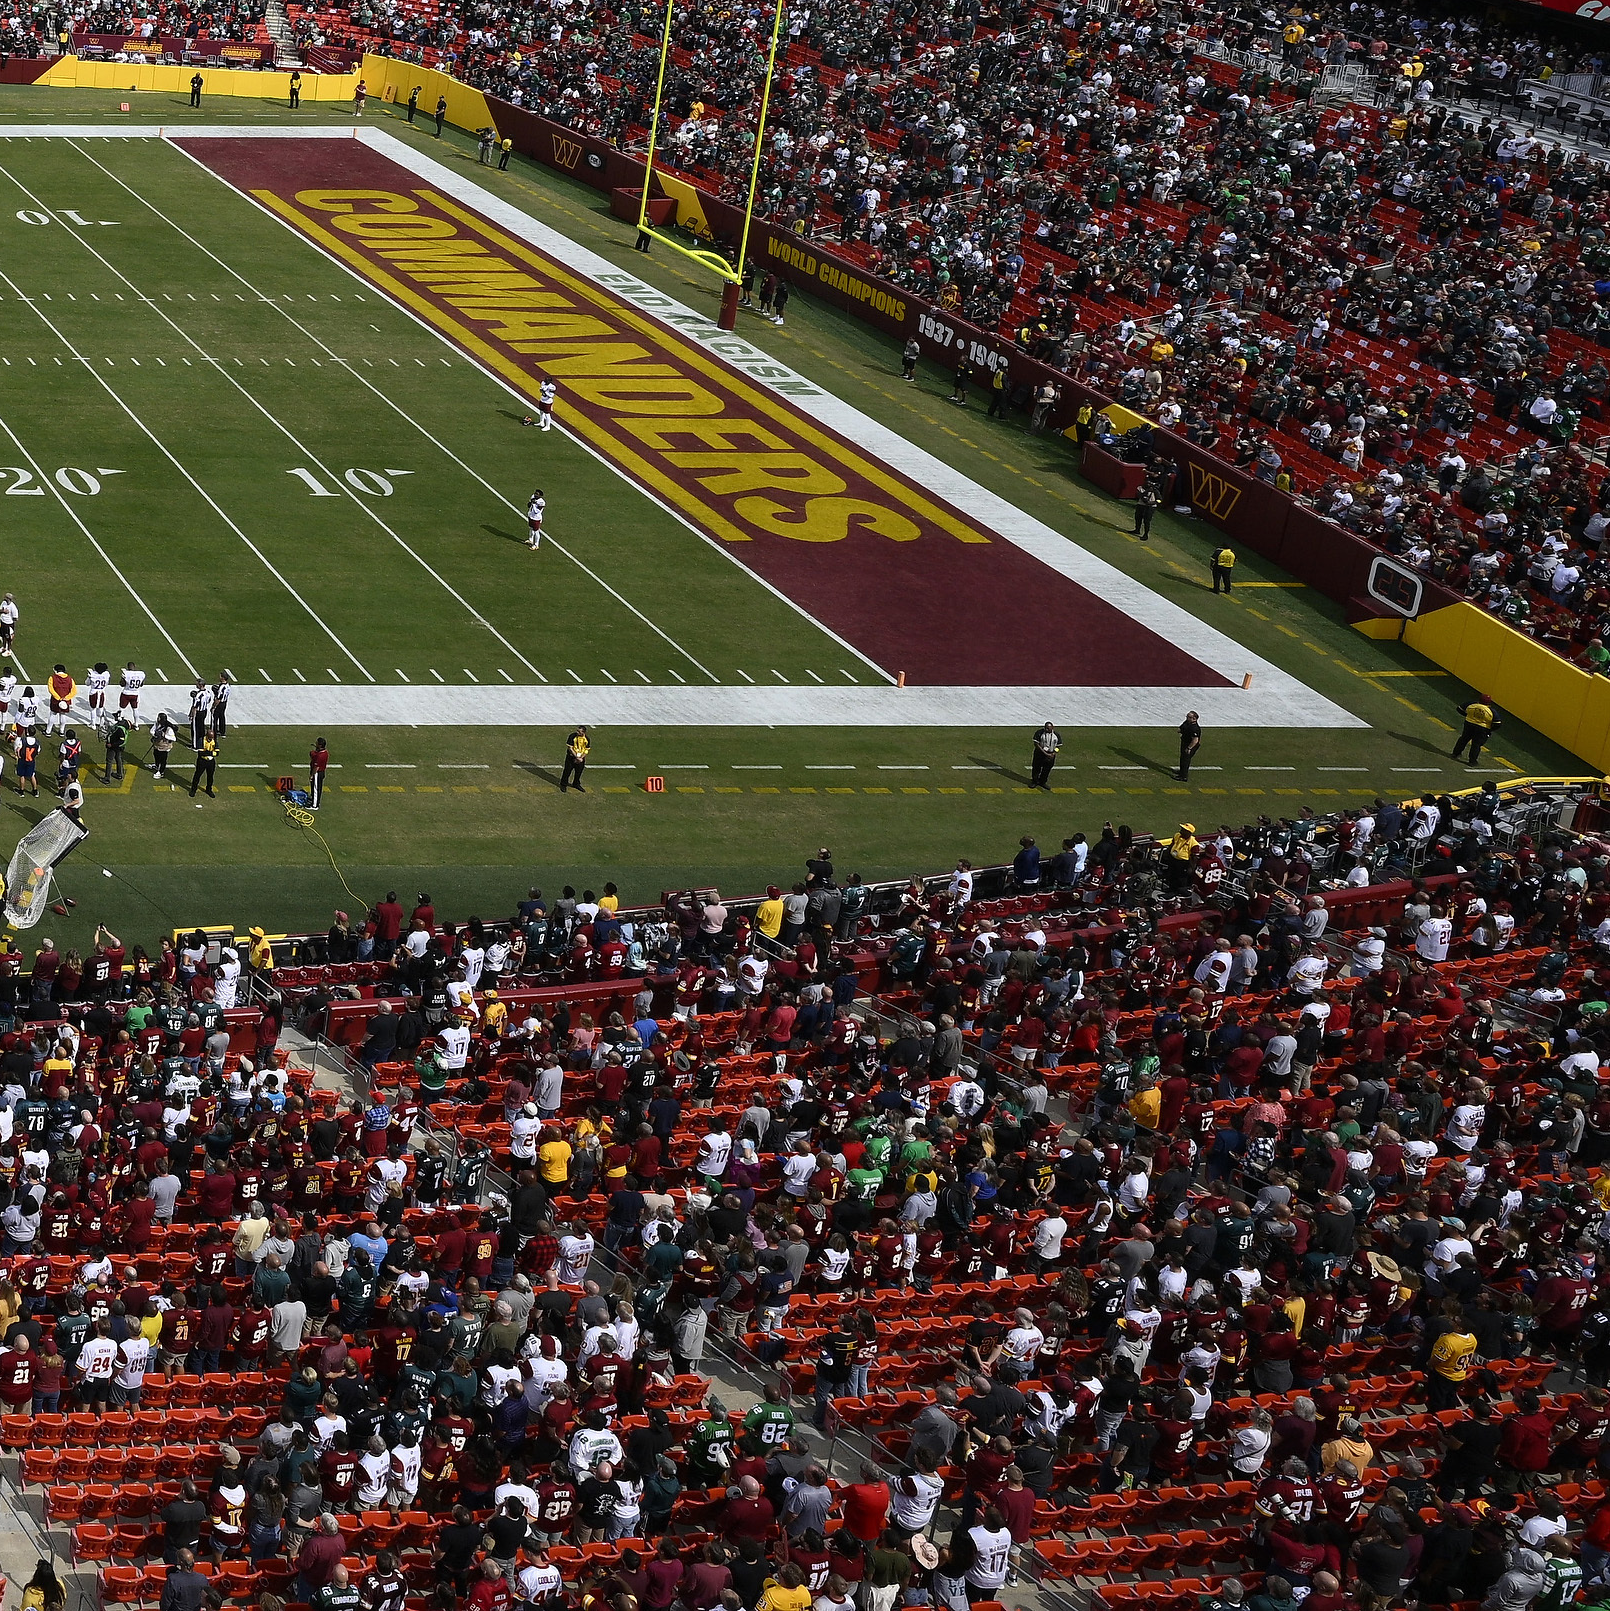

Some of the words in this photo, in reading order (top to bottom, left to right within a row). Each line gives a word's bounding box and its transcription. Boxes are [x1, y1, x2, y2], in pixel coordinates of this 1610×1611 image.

[221, 49, 261, 59] COMMANDERS
[594, 274, 673, 307] END
[767, 235, 816, 274] WORLD
[818, 257, 907, 322] CHAMPIONS
[919, 313, 955, 349] 1937
[295, 189, 923, 543] COMMANDERS
[663, 312, 824, 397] RACISM
[286, 467, 394, 498] 10
[1378, 568, 1411, 607] 25
[93, 1357, 111, 1373] 24
[763, 1423, 789, 1443] 82
